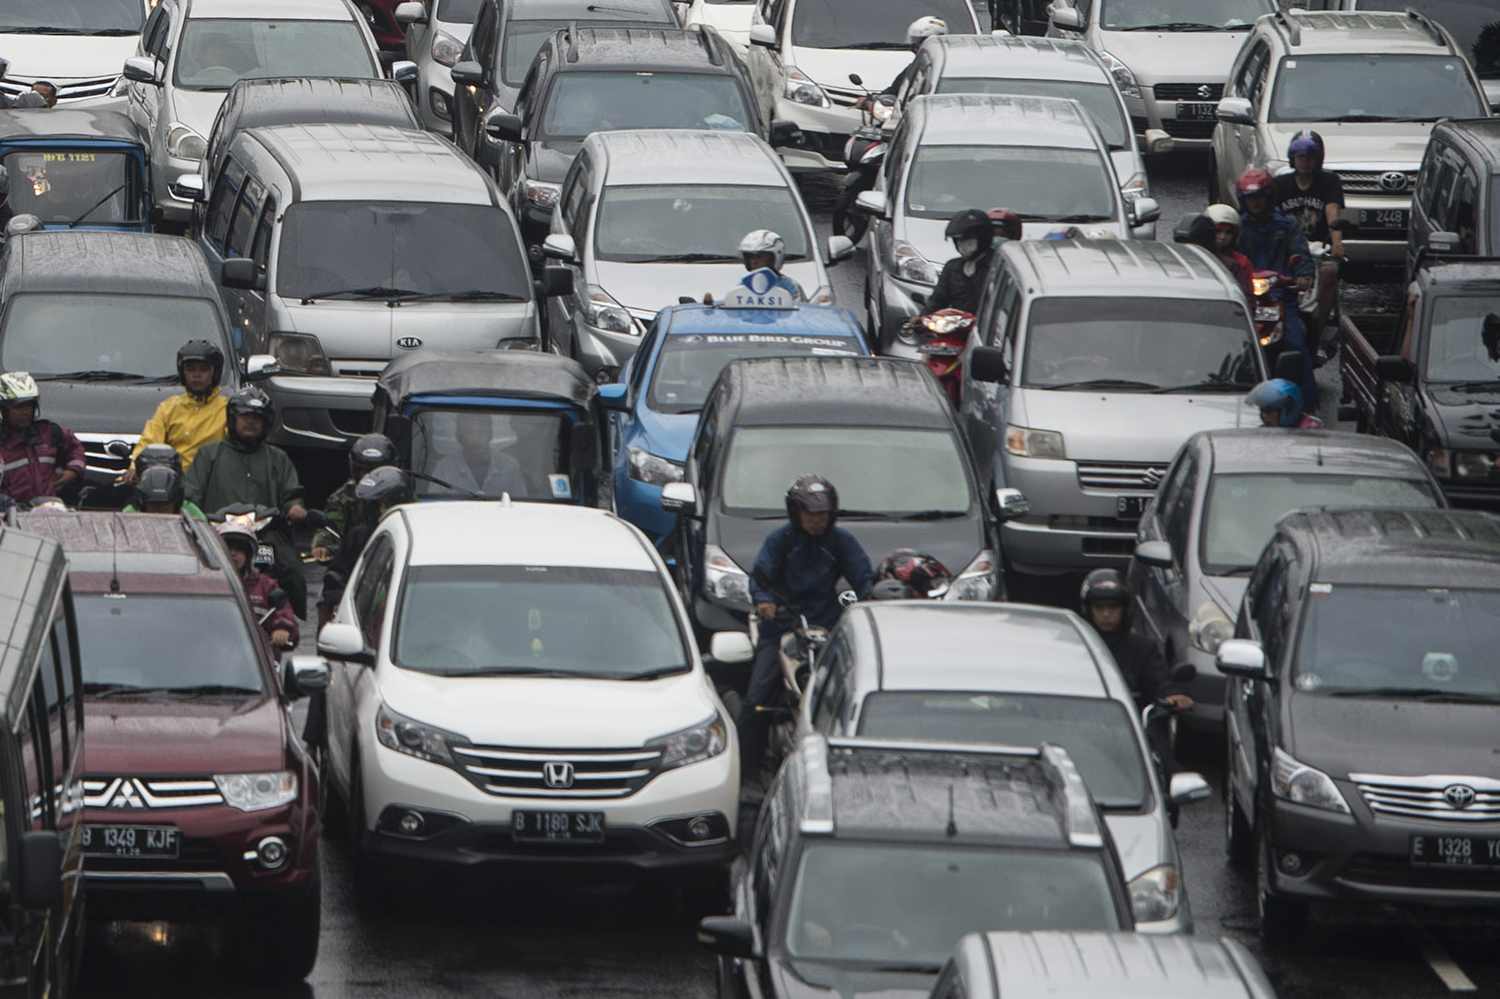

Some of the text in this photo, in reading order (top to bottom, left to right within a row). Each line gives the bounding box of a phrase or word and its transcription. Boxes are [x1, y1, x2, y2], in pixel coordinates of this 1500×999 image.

[736, 296, 782, 306] TAKSI
[400, 338, 420, 346] KIA
[707, 335, 846, 347] BLUE BIRD GROUP
[515, 812, 602, 833] B 1180 SJK
[82, 828, 176, 849] B 1349 KJF
[1413, 836, 1424, 856] E
[1438, 837, 1472, 856] 1328
